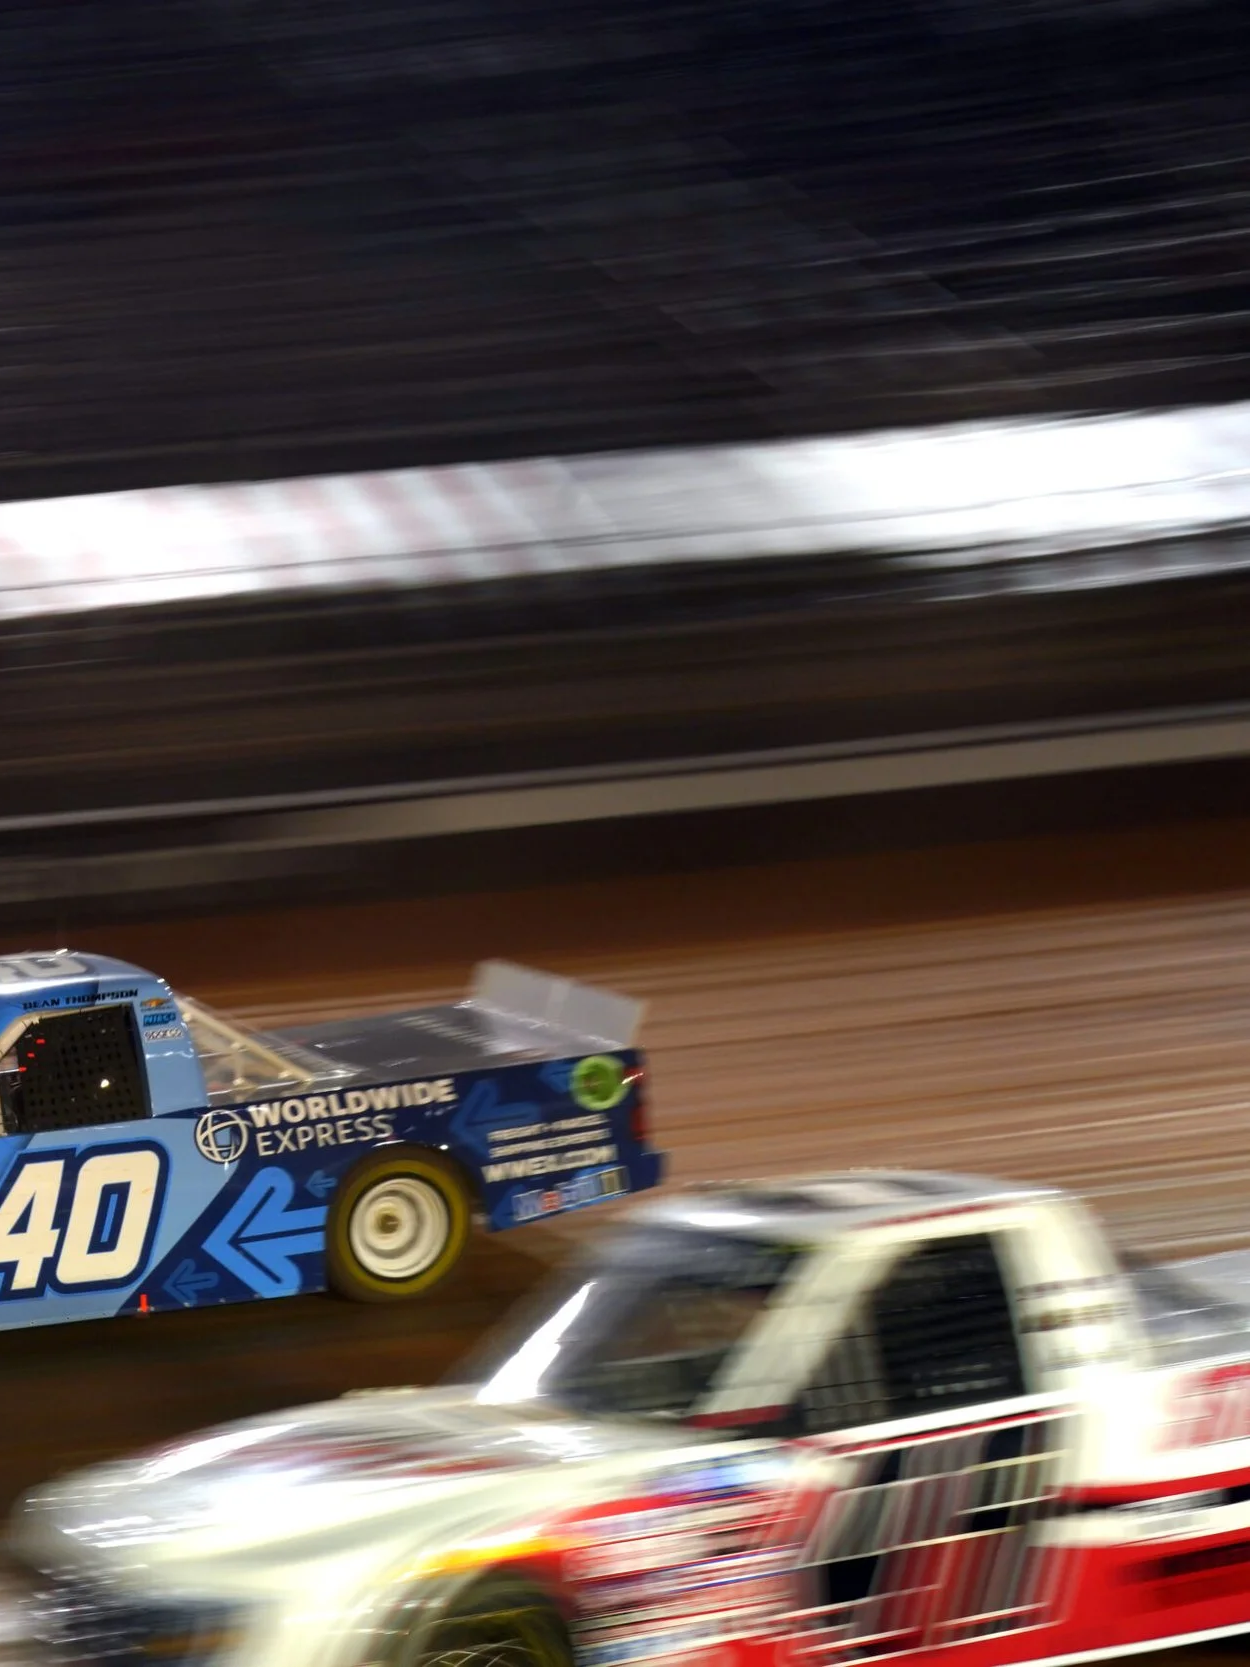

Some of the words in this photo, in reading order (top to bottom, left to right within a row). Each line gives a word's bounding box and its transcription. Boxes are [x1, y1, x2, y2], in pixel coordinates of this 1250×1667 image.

[22, 997, 61, 1011] DEAN
[65, 987, 139, 1006] THOMPSON
[249, 1078, 460, 1128] WORLDWIDE
[256, 1114, 395, 1156] EXPRESS
